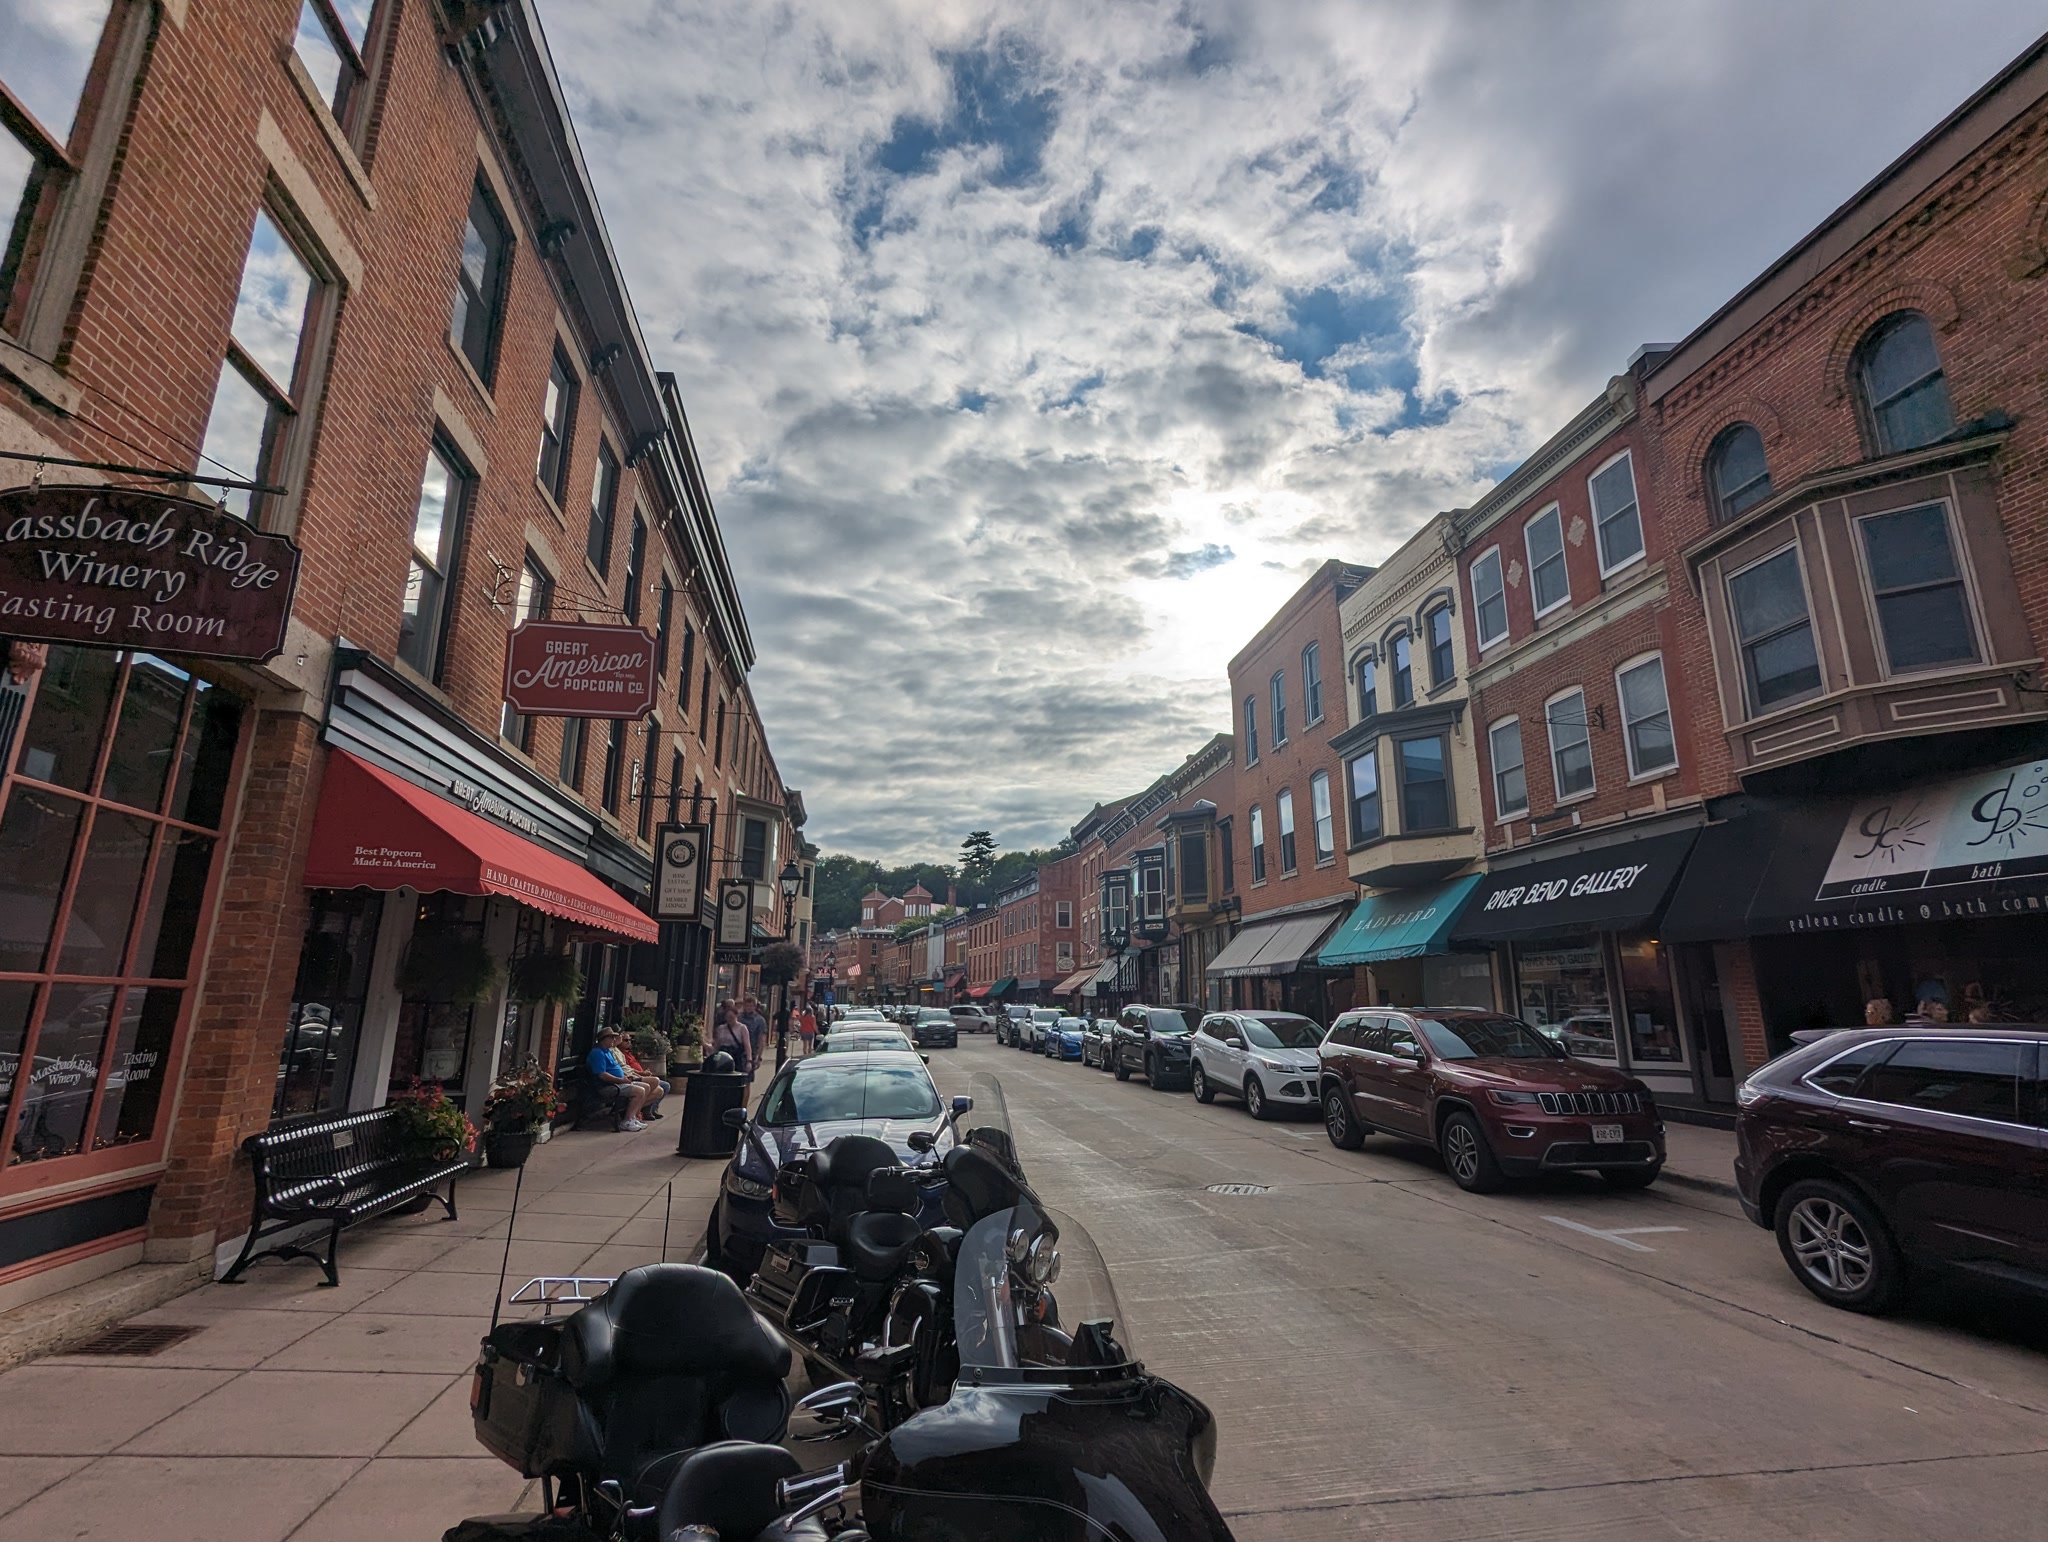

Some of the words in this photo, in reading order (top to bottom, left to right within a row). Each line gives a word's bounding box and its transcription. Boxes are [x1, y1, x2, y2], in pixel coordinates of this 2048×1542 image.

[0, 498, 175, 551] assbach
[181, 528, 280, 589] Ridge
[38, 549, 187, 603] Winery
[127, 604, 226, 637] Room
[545, 640, 589, 656] GREAT
[513, 651, 648, 689] American
[563, 678, 624, 693] POPCORN
[453, 779, 475, 802] GREAT
[354, 845, 378, 856] Best
[379, 847, 422, 859] Popcorn
[352, 857, 381, 867] Made
[382, 858, 393, 867] in
[393, 859, 436, 870] America
[1971, 862, 2003, 879] bath
[486, 868, 508, 884] HAND
[509, 876, 540, 896] CRAFTED
[540, 887, 568, 905] POPCORN
[1483, 886, 1526, 911] RIVER
[1522, 879, 1568, 905] BEND
[1569, 863, 1648, 897] GALLERY
[1850, 878, 1888, 895] candle
[1353, 907, 1437, 931] LADYBIRD
[1789, 913, 1839, 933] galena
[1849, 904, 1904, 925] candle
[1942, 897, 1987, 916] bath
[122, 1048, 158, 1068] Tasting
[48, 1071, 81, 1086] Winery
[123, 1068, 151, 1081] Room
